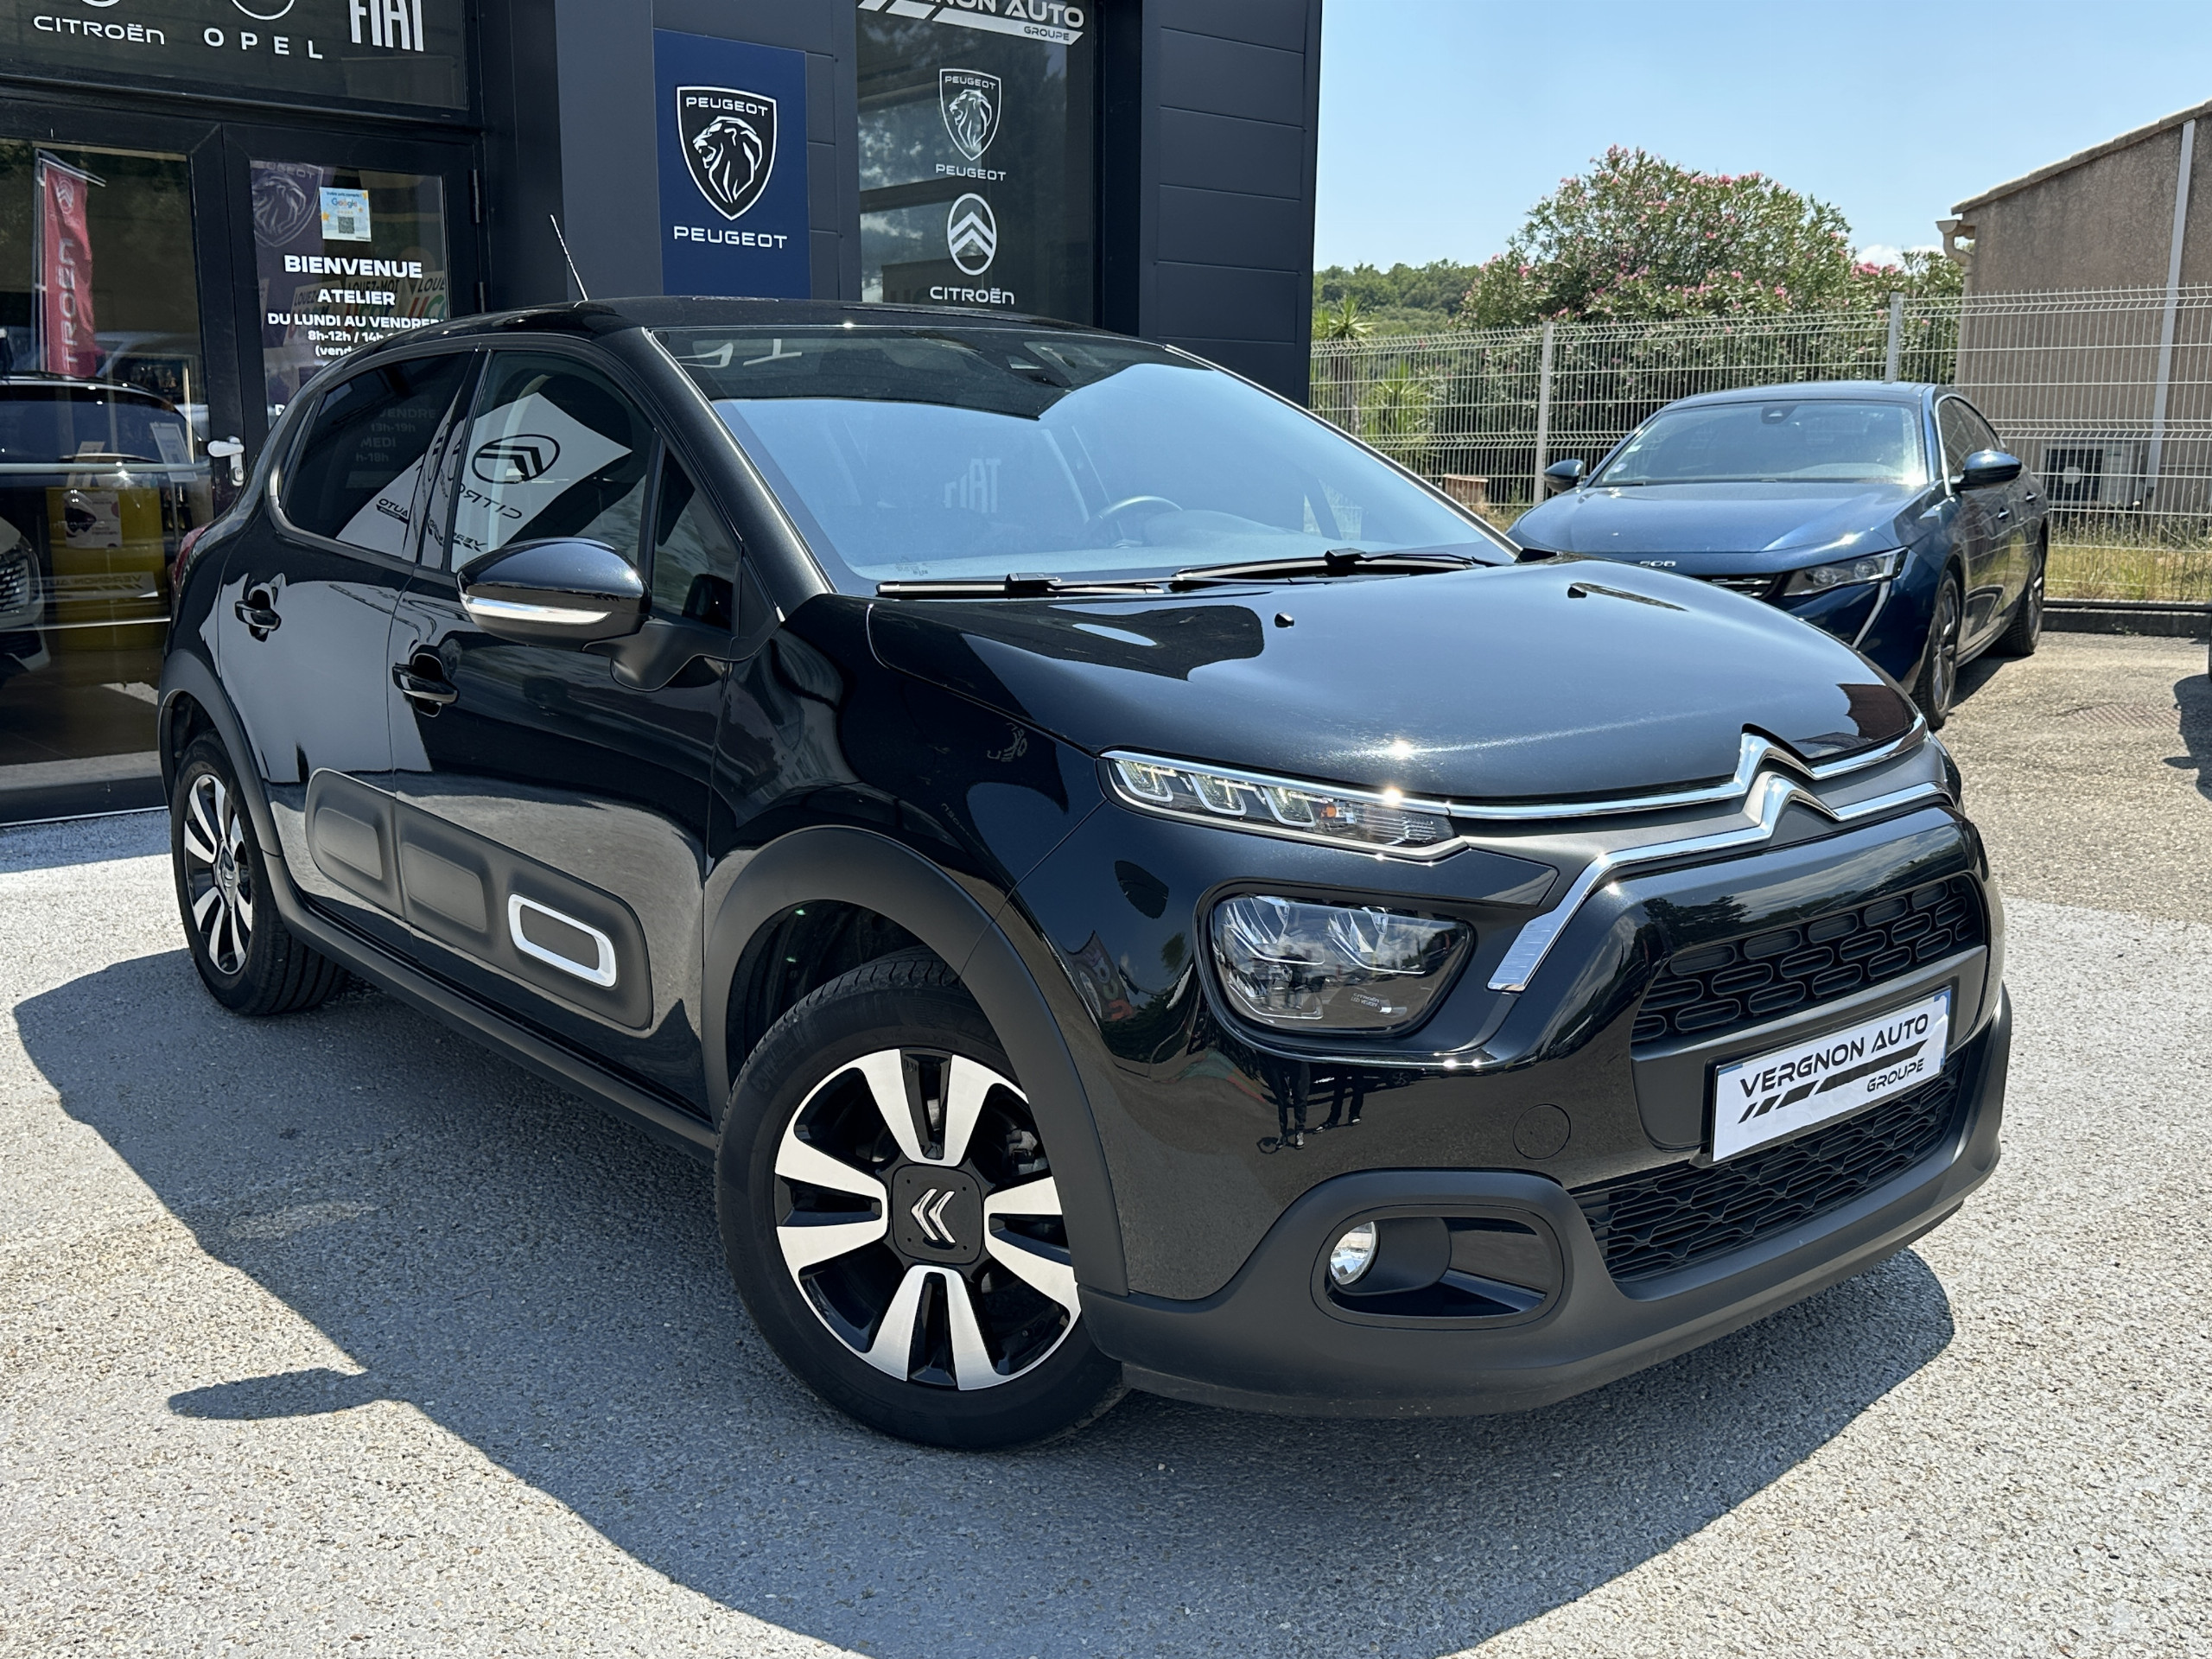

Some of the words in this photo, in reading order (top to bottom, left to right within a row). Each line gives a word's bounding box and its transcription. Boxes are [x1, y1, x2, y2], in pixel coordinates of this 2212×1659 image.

[1005, 0, 1084, 28] AUTO
[1024, 26, 1070, 41] GROUPE
[204, 28, 323, 60] OPEL
[945, 75, 996, 90] PEUGEOT
[686, 97, 768, 117] PEUGEOT
[936, 163, 1007, 181] PEUGEOT
[674, 226, 788, 249] PEUGEOT
[283, 255, 423, 278] BIENVENUE
[317, 289, 396, 306] ATELIER
[268, 312, 291, 325] DU
[294, 313, 341, 327] LUNDI
[344, 315, 367, 327] AU
[369, 316, 444, 329] VENDRE
[308, 330, 352, 342] 8h-12h
[353, 331, 359, 343] /
[359, 435, 397, 448] MEDI
[1739, 1037, 1866, 1098] VERGNON
[1871, 1014, 1929, 1053] AUTO
[1866, 1058, 1925, 1092] GROUPE
